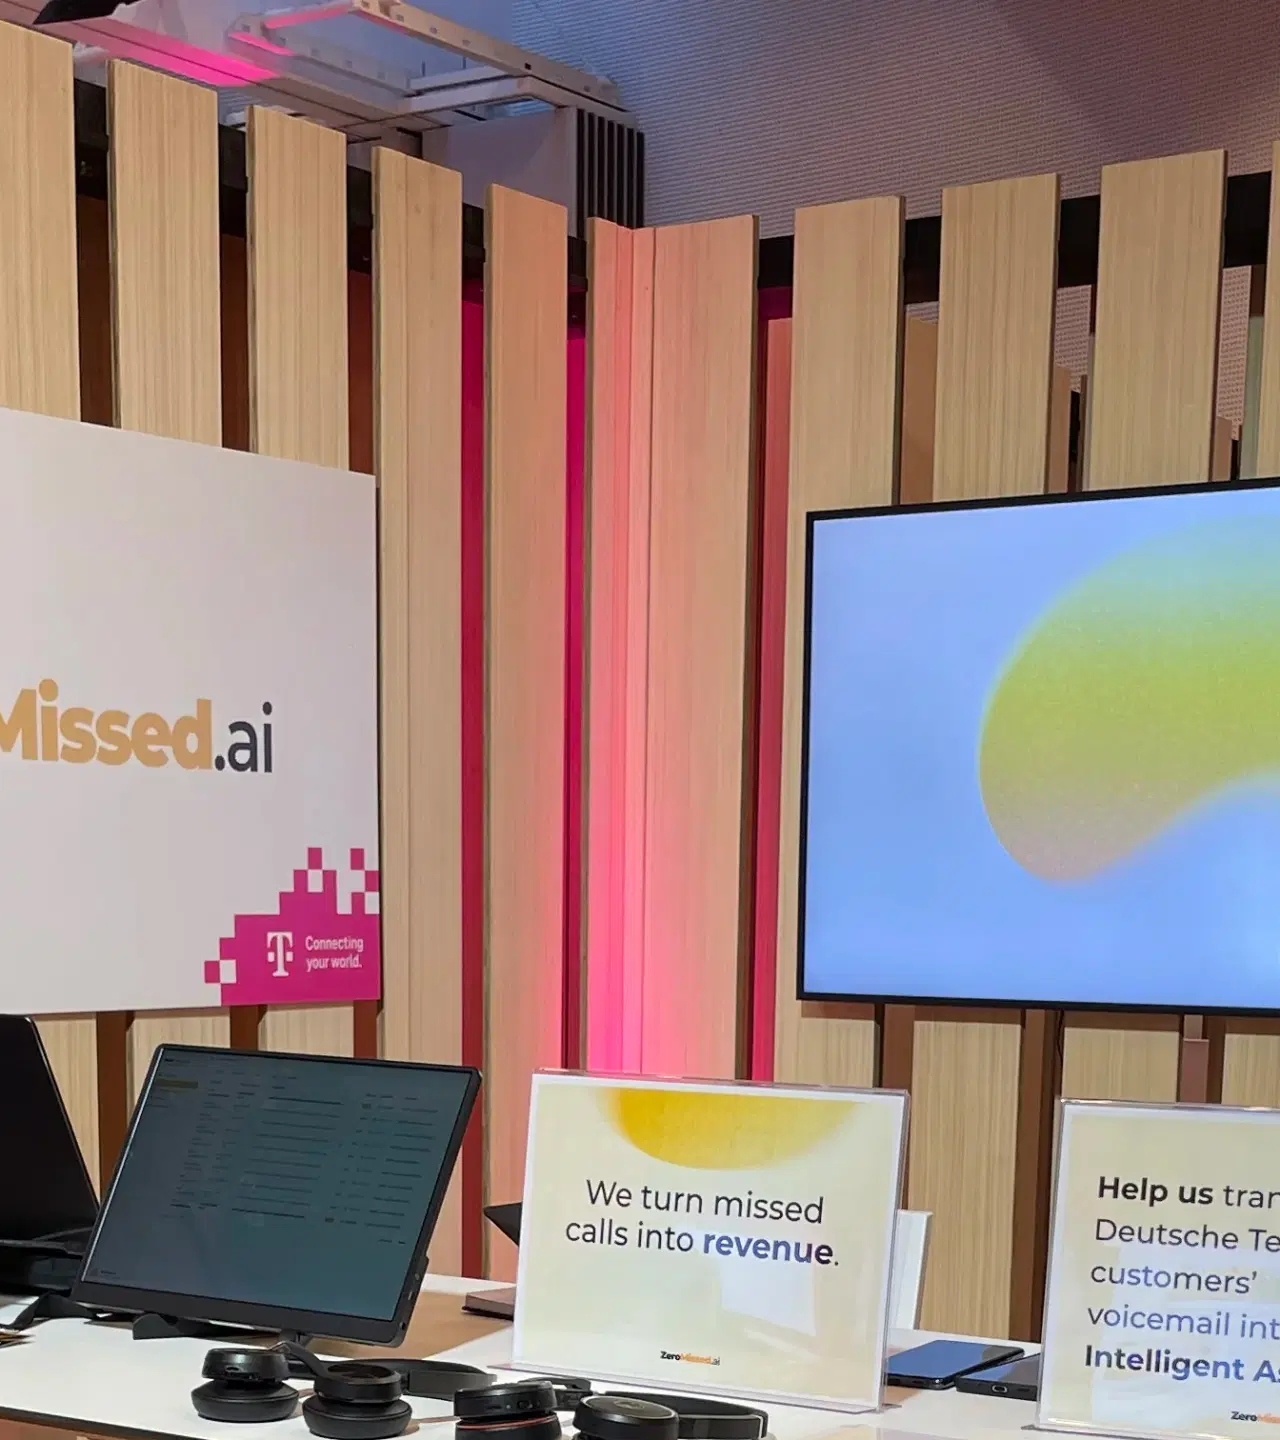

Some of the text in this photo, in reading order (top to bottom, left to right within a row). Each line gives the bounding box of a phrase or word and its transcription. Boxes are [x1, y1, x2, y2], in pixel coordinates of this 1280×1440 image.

[266, 931, 293, 977] T
[305, 936, 364, 953] Connecting
[306, 954, 362, 973] your world.
[586, 1179, 824, 1224] We turn missed
[1097, 1176, 1168, 1207] Help
[1178, 1184, 1214, 1205] us
[565, 1218, 839, 1266] calls into revenue.
[1095, 1218, 1240, 1251] Deutsche
[1090, 1264, 1258, 1295] customers’
[1087, 1304, 1231, 1336] voicemail
[1084, 1344, 1245, 1381] Intelligent
